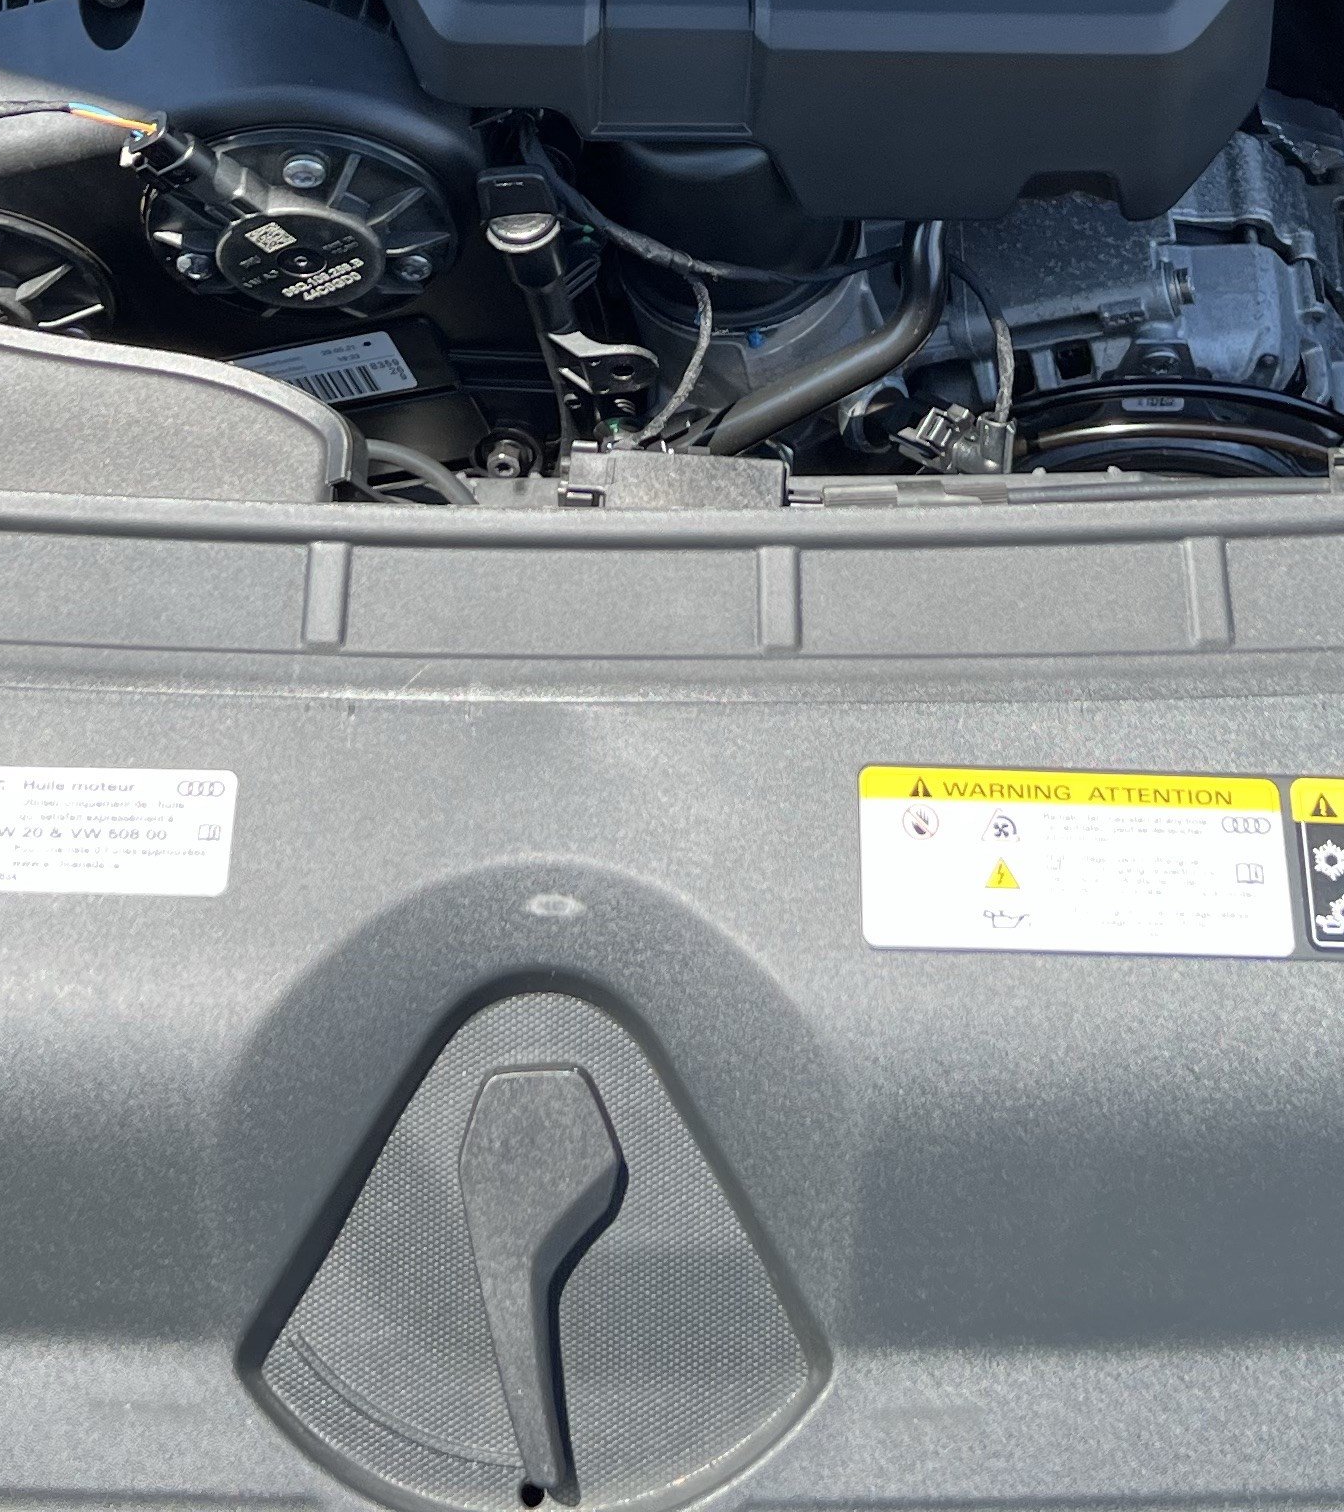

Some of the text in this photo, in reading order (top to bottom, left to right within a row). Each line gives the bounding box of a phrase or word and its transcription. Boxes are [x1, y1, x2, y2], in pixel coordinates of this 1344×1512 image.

[23, 779, 135, 792] Huile moteur
[943, 781, 1233, 806] WARNING ATTENTION
[22, 827, 43, 838] 20
[50, 828, 62, 839] &
[71, 828, 101, 840] VW
[146, 830, 167, 841] 00
